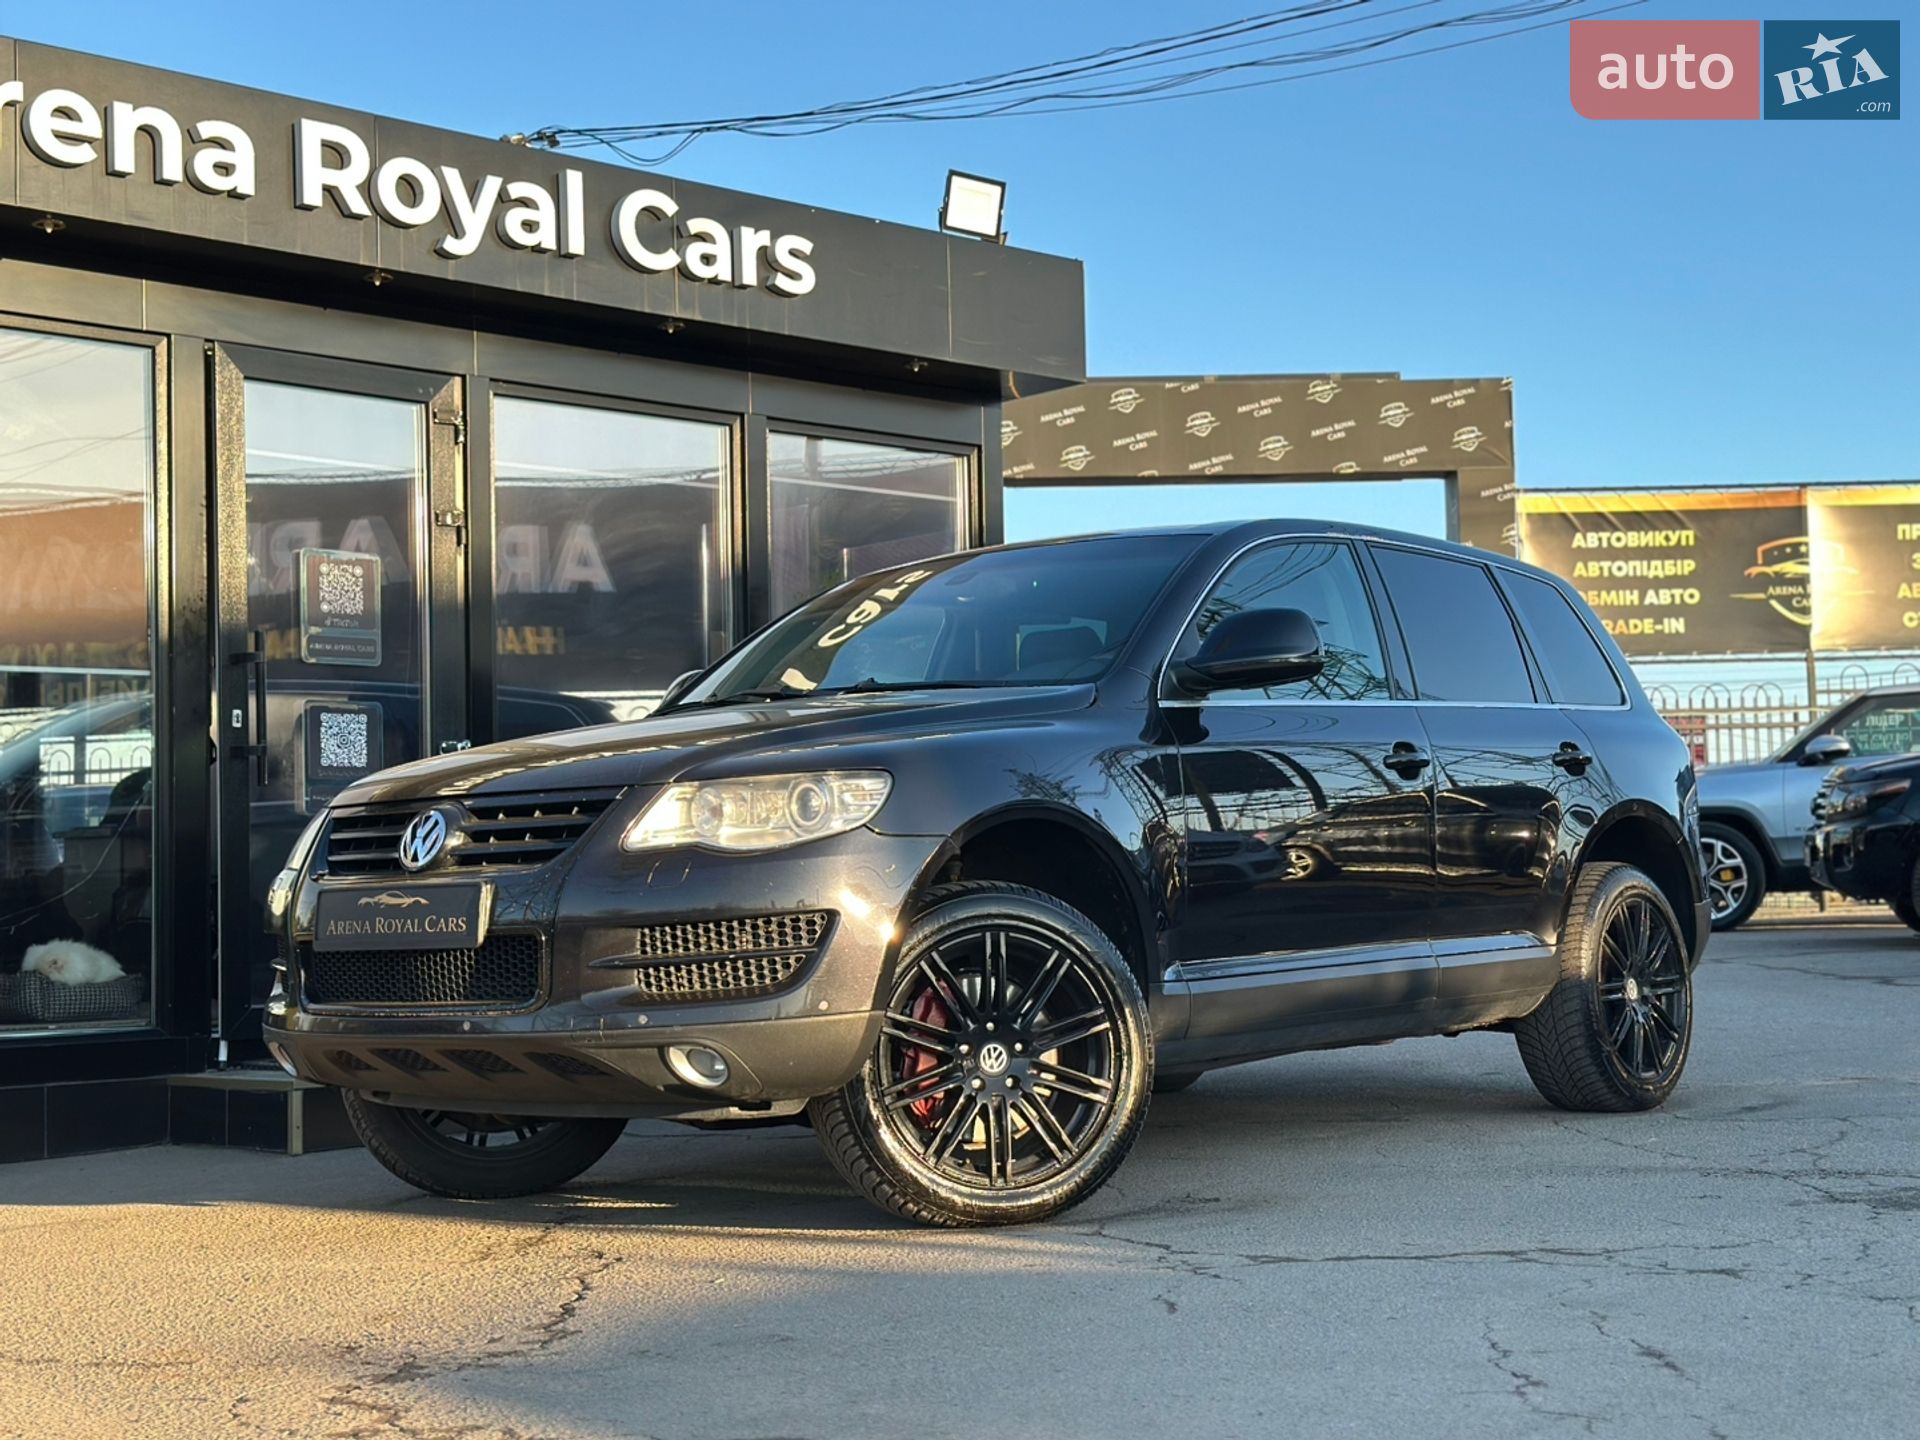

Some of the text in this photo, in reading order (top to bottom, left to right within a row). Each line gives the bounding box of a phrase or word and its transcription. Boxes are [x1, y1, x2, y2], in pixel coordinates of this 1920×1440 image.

[0, 81, 816, 298] rena Royal Cars
[1571, 530, 1695, 549] АВТОВИКУП
[1573, 559, 1697, 579] АВТОПІДБІР
[1644, 587, 1701, 605] АВТО
[1601, 617, 1685, 634] RADE-IN
[326, 915, 467, 935] ARENA ROYAL CARS
